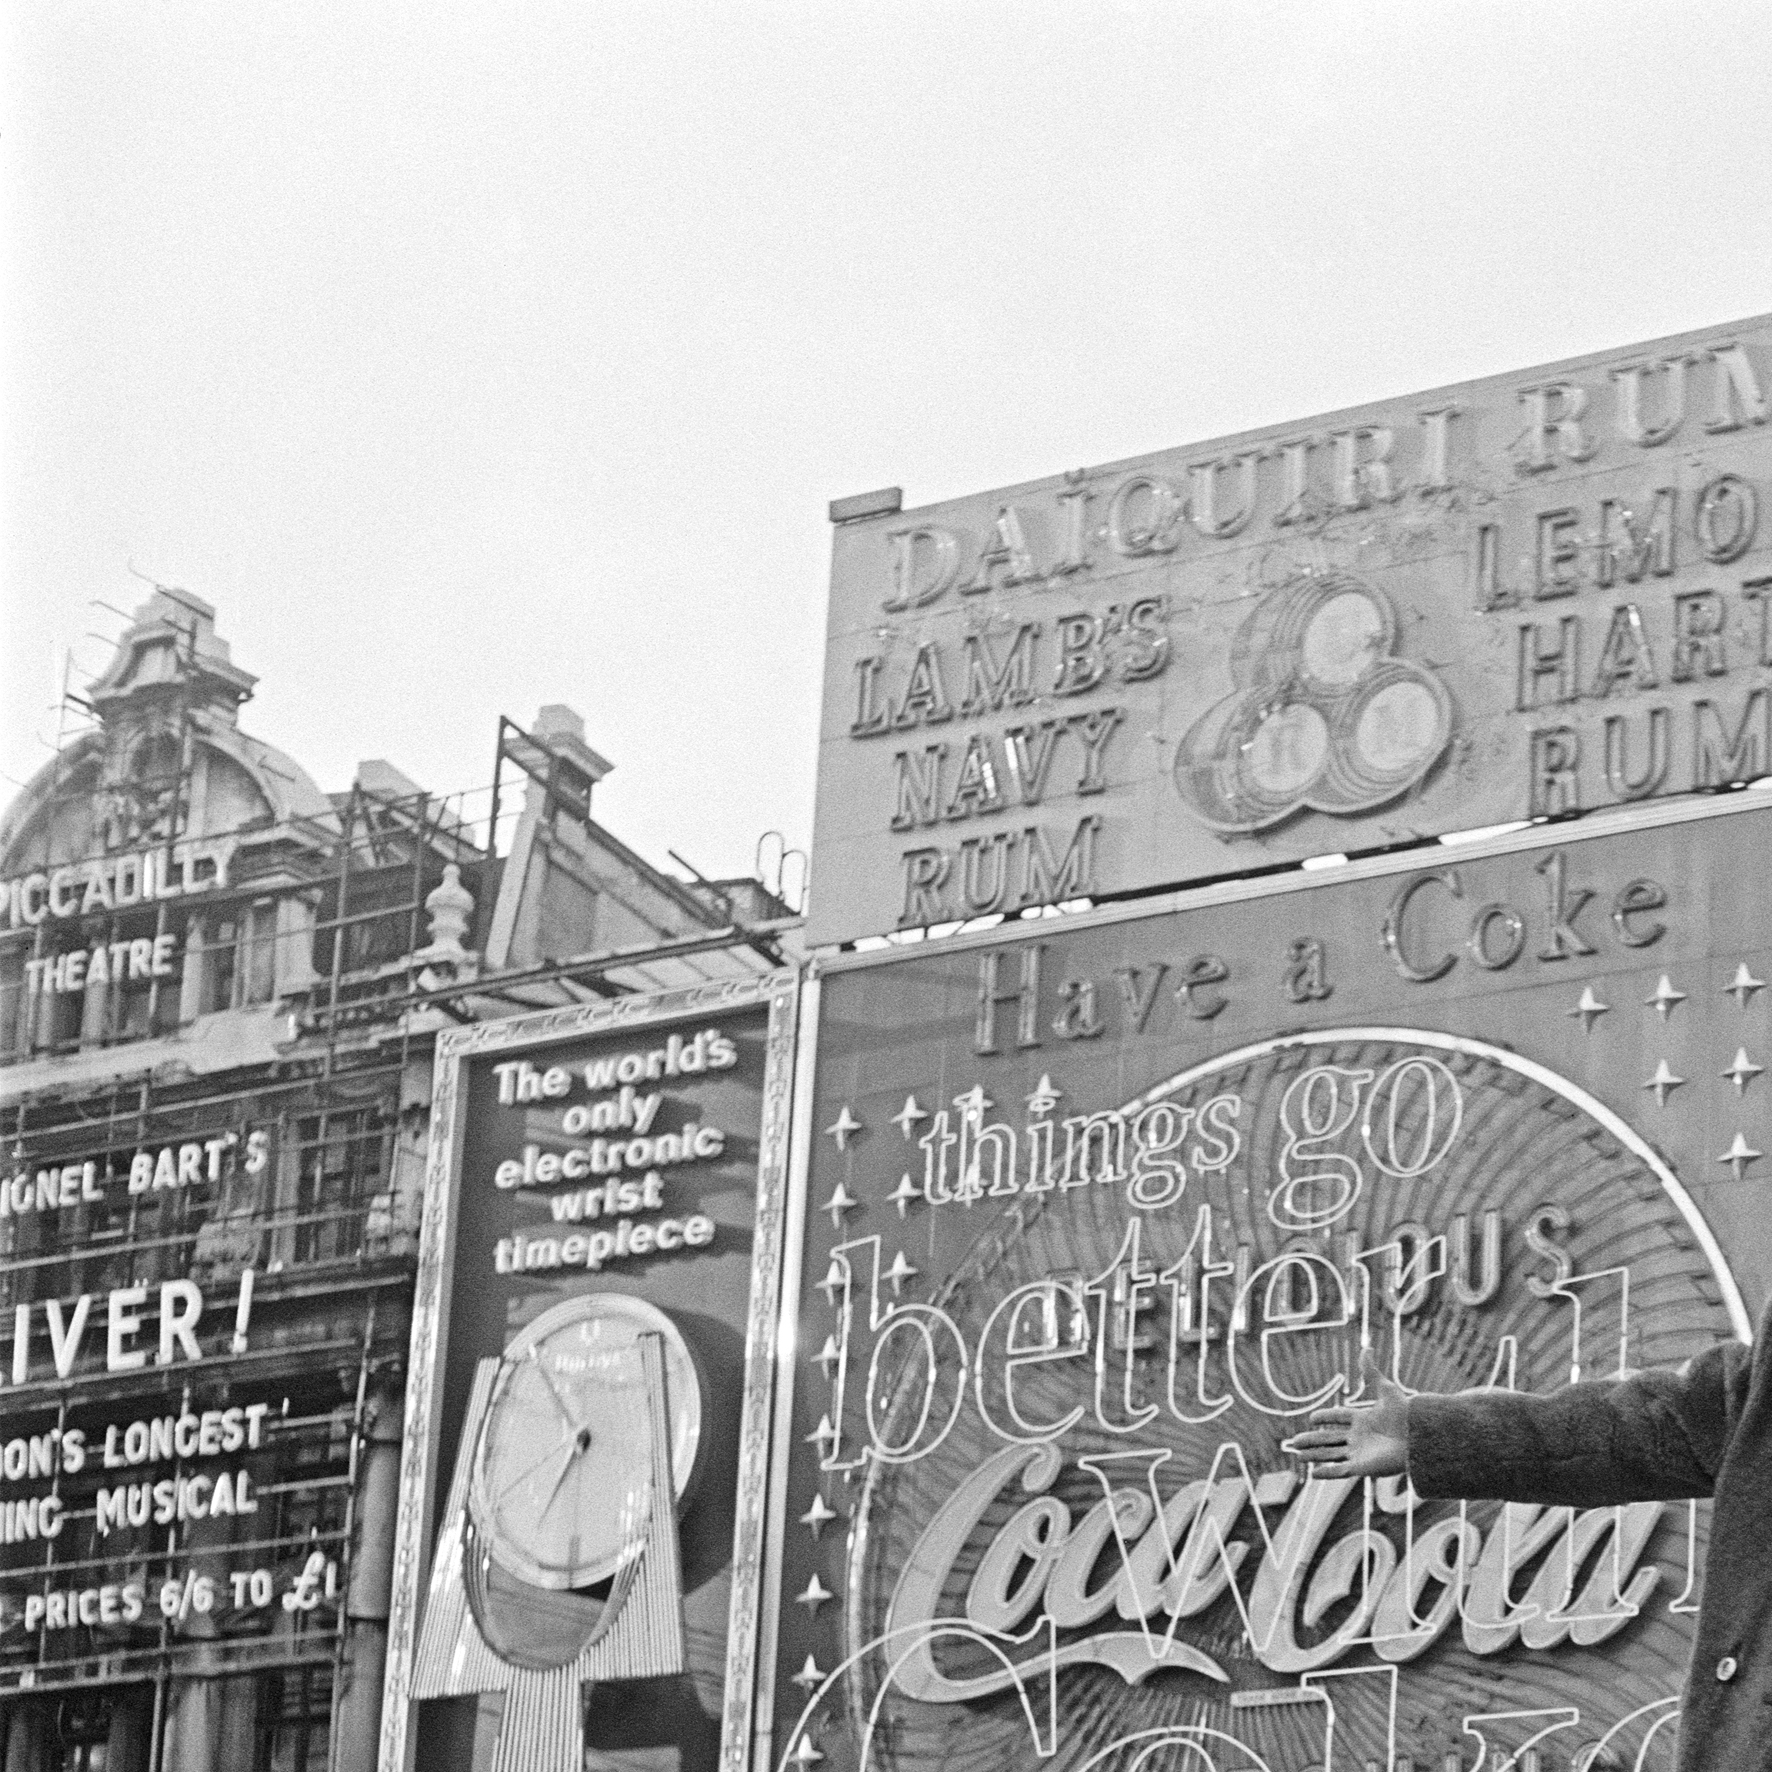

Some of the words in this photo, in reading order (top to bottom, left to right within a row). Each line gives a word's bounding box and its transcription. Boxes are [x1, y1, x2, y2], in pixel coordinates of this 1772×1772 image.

[883, 405, 1461, 614] DAIQUIRI
[851, 596, 1172, 739] LAMB'S
[890, 706, 1123, 832] NAVY
[1528, 687, 1772, 816] RUM
[899, 815, 1101, 925] RUM
[26, 934, 176, 994] THEATRE
[971, 944, 1231, 1057] Have
[1280, 937, 1334, 1003] a
[1379, 851, 1671, 982] Coke
[492, 1060, 572, 1105] The
[584, 1028, 738, 1090] world's
[562, 1086, 664, 1136] only
[918, 1090, 1242, 1210] things
[1268, 1055, 1463, 1230] go
[127, 1130, 270, 1195] BART'S
[494, 1122, 726, 1189] electronic
[551, 1169, 665, 1222] wrist
[493, 1214, 717, 1274] timepiece
[829, 1203, 1447, 1472] better
[0, 1428, 87, 1481] ON'S
[104, 1402, 269, 1469] LONGEST
[0, 1496, 64, 1544] ING
[96, 1469, 259, 1533] MUSICAL
[25, 1583, 146, 1633] PRICES
[159, 1569, 215, 1621] 6/6
[229, 1568, 274, 1610] TO
[282, 1550, 339, 1613] £1
[884, 1440, 1664, 1703] Coca-Cola
